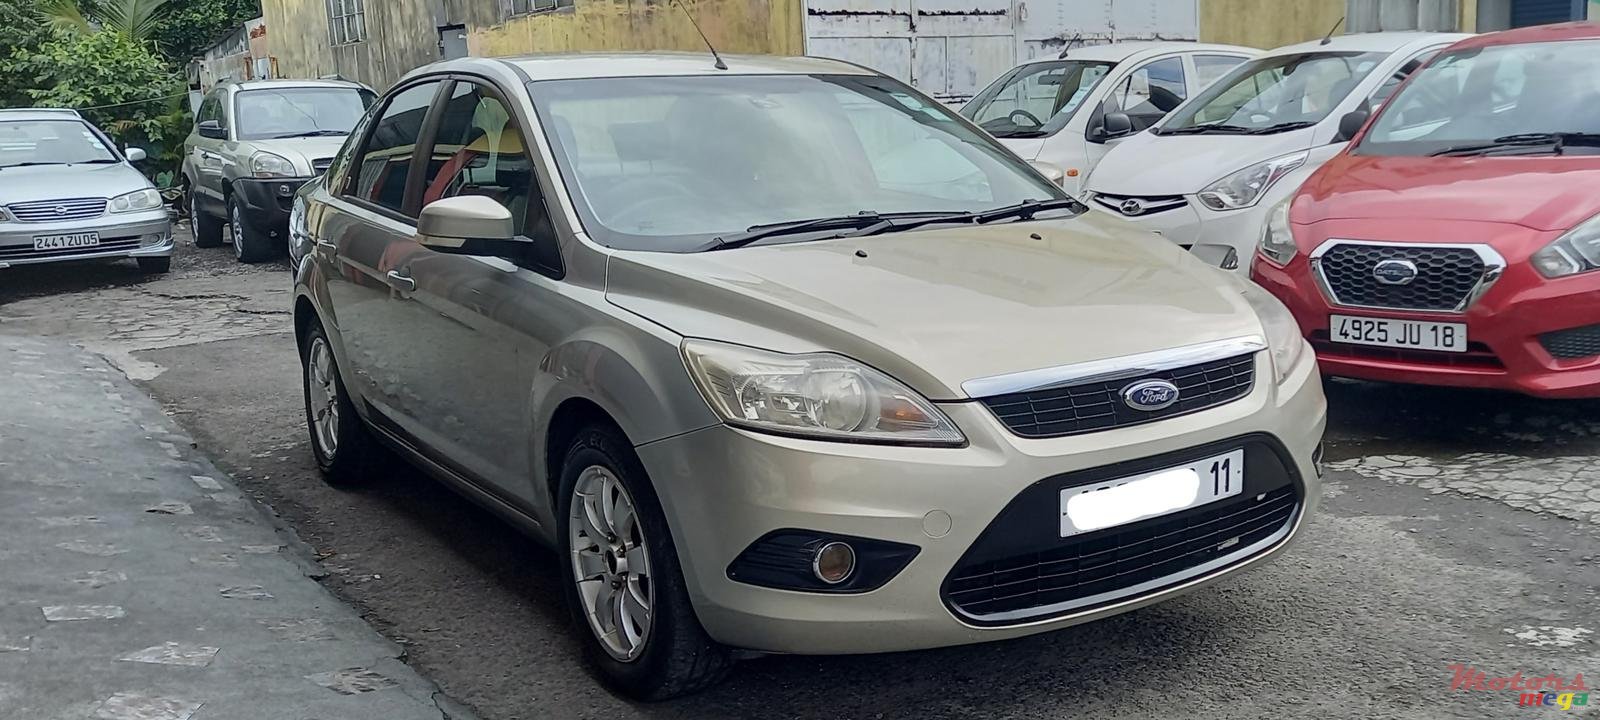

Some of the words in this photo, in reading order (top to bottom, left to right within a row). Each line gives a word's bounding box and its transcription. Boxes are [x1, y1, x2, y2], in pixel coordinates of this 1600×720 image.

[1339, 318, 1389, 343] 4925
[1395, 323, 1421, 345] JU
[1430, 325, 1455, 348] 18
[1140, 387, 1169, 404] Ford
[1210, 457, 1231, 496] 11
